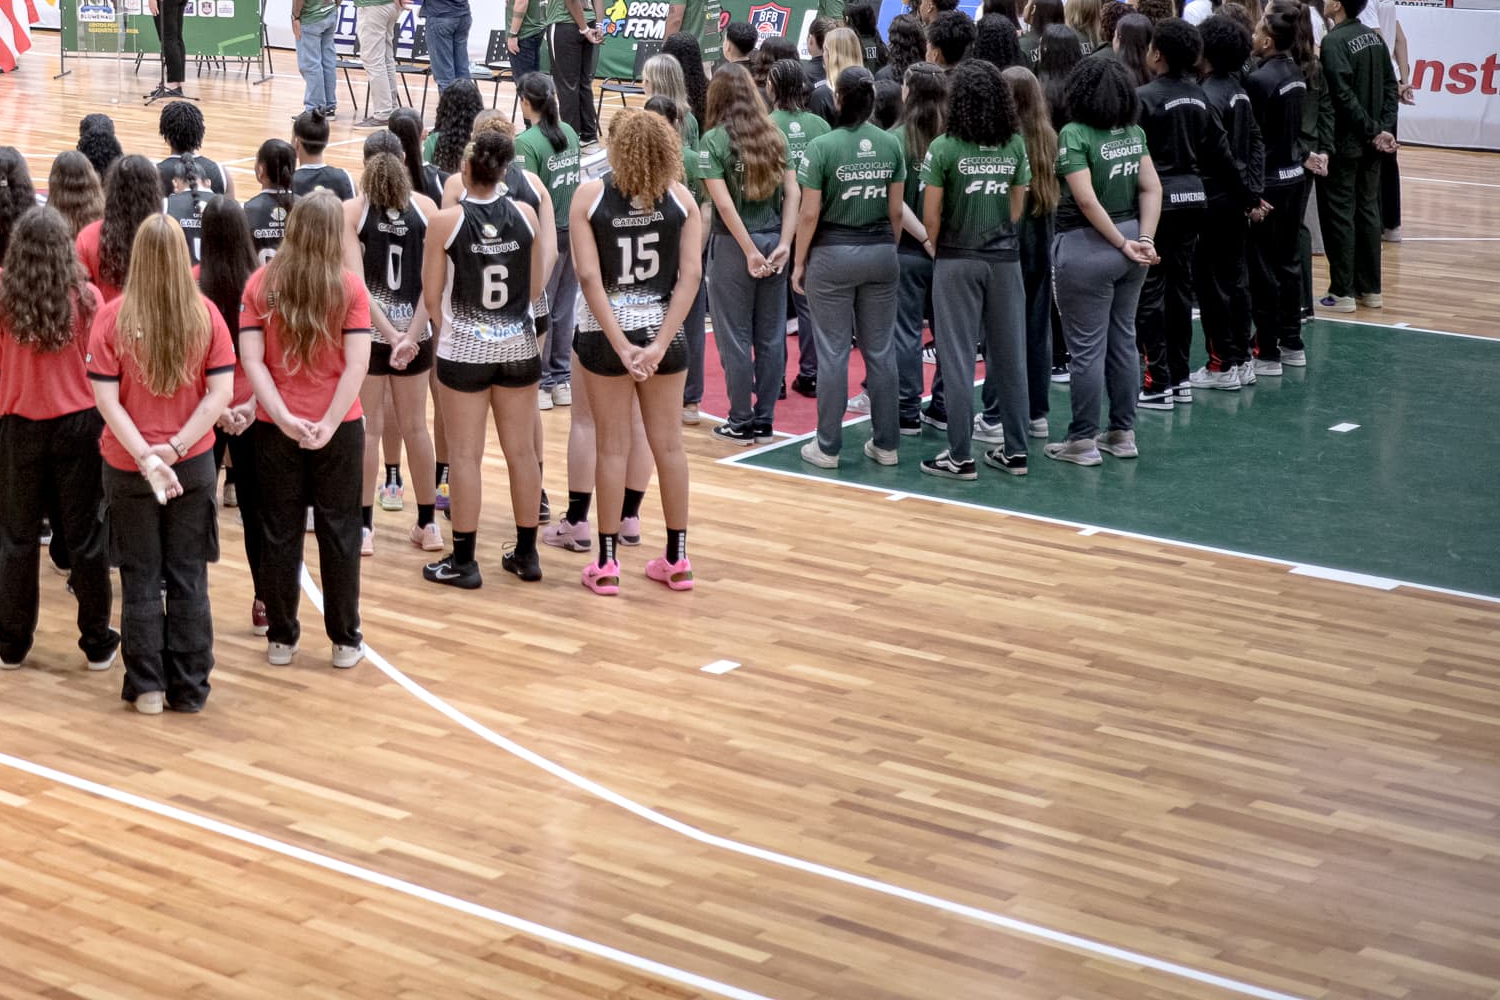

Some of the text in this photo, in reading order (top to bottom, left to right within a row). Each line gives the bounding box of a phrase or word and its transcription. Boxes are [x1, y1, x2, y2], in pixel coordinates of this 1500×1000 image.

[759, 11, 779, 22] BFB
[553, 157, 580, 169] BASQUE
[967, 165, 1015, 175] BASQUETE
[985, 180, 1009, 194] Frt
[617, 232, 660, 285] 15
[482, 264, 509, 310] 6
